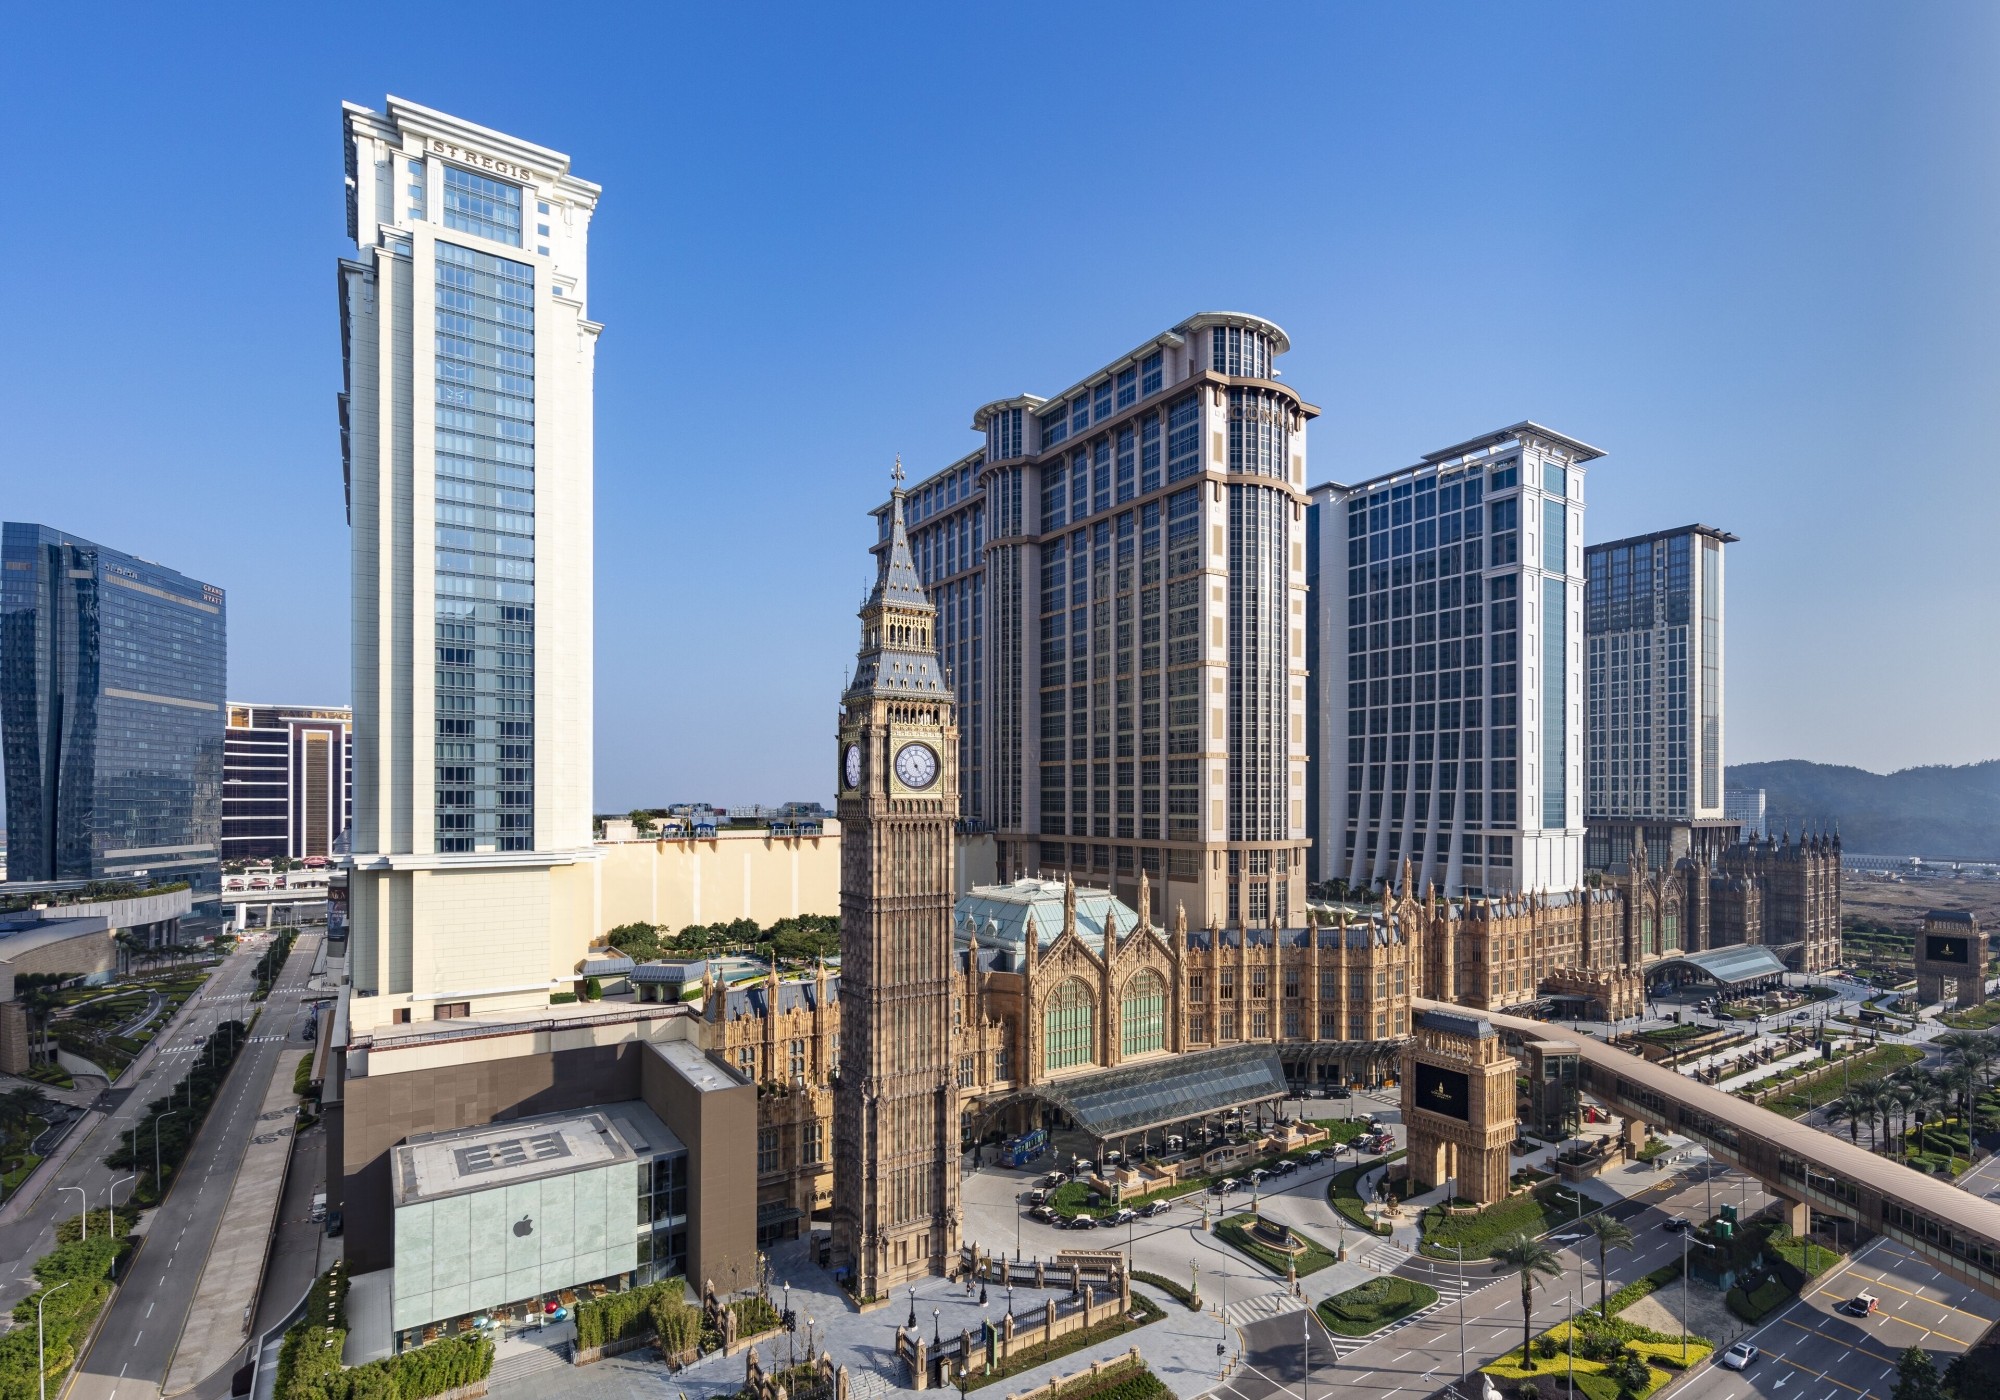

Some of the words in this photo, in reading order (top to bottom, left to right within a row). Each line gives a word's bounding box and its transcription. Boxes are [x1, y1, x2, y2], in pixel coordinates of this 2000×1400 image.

[433, 140, 459, 157] ST
[464, 150, 530, 180] REGIS
[203, 584, 223, 596] GRAND
[203, 593, 222, 605] HYATT
